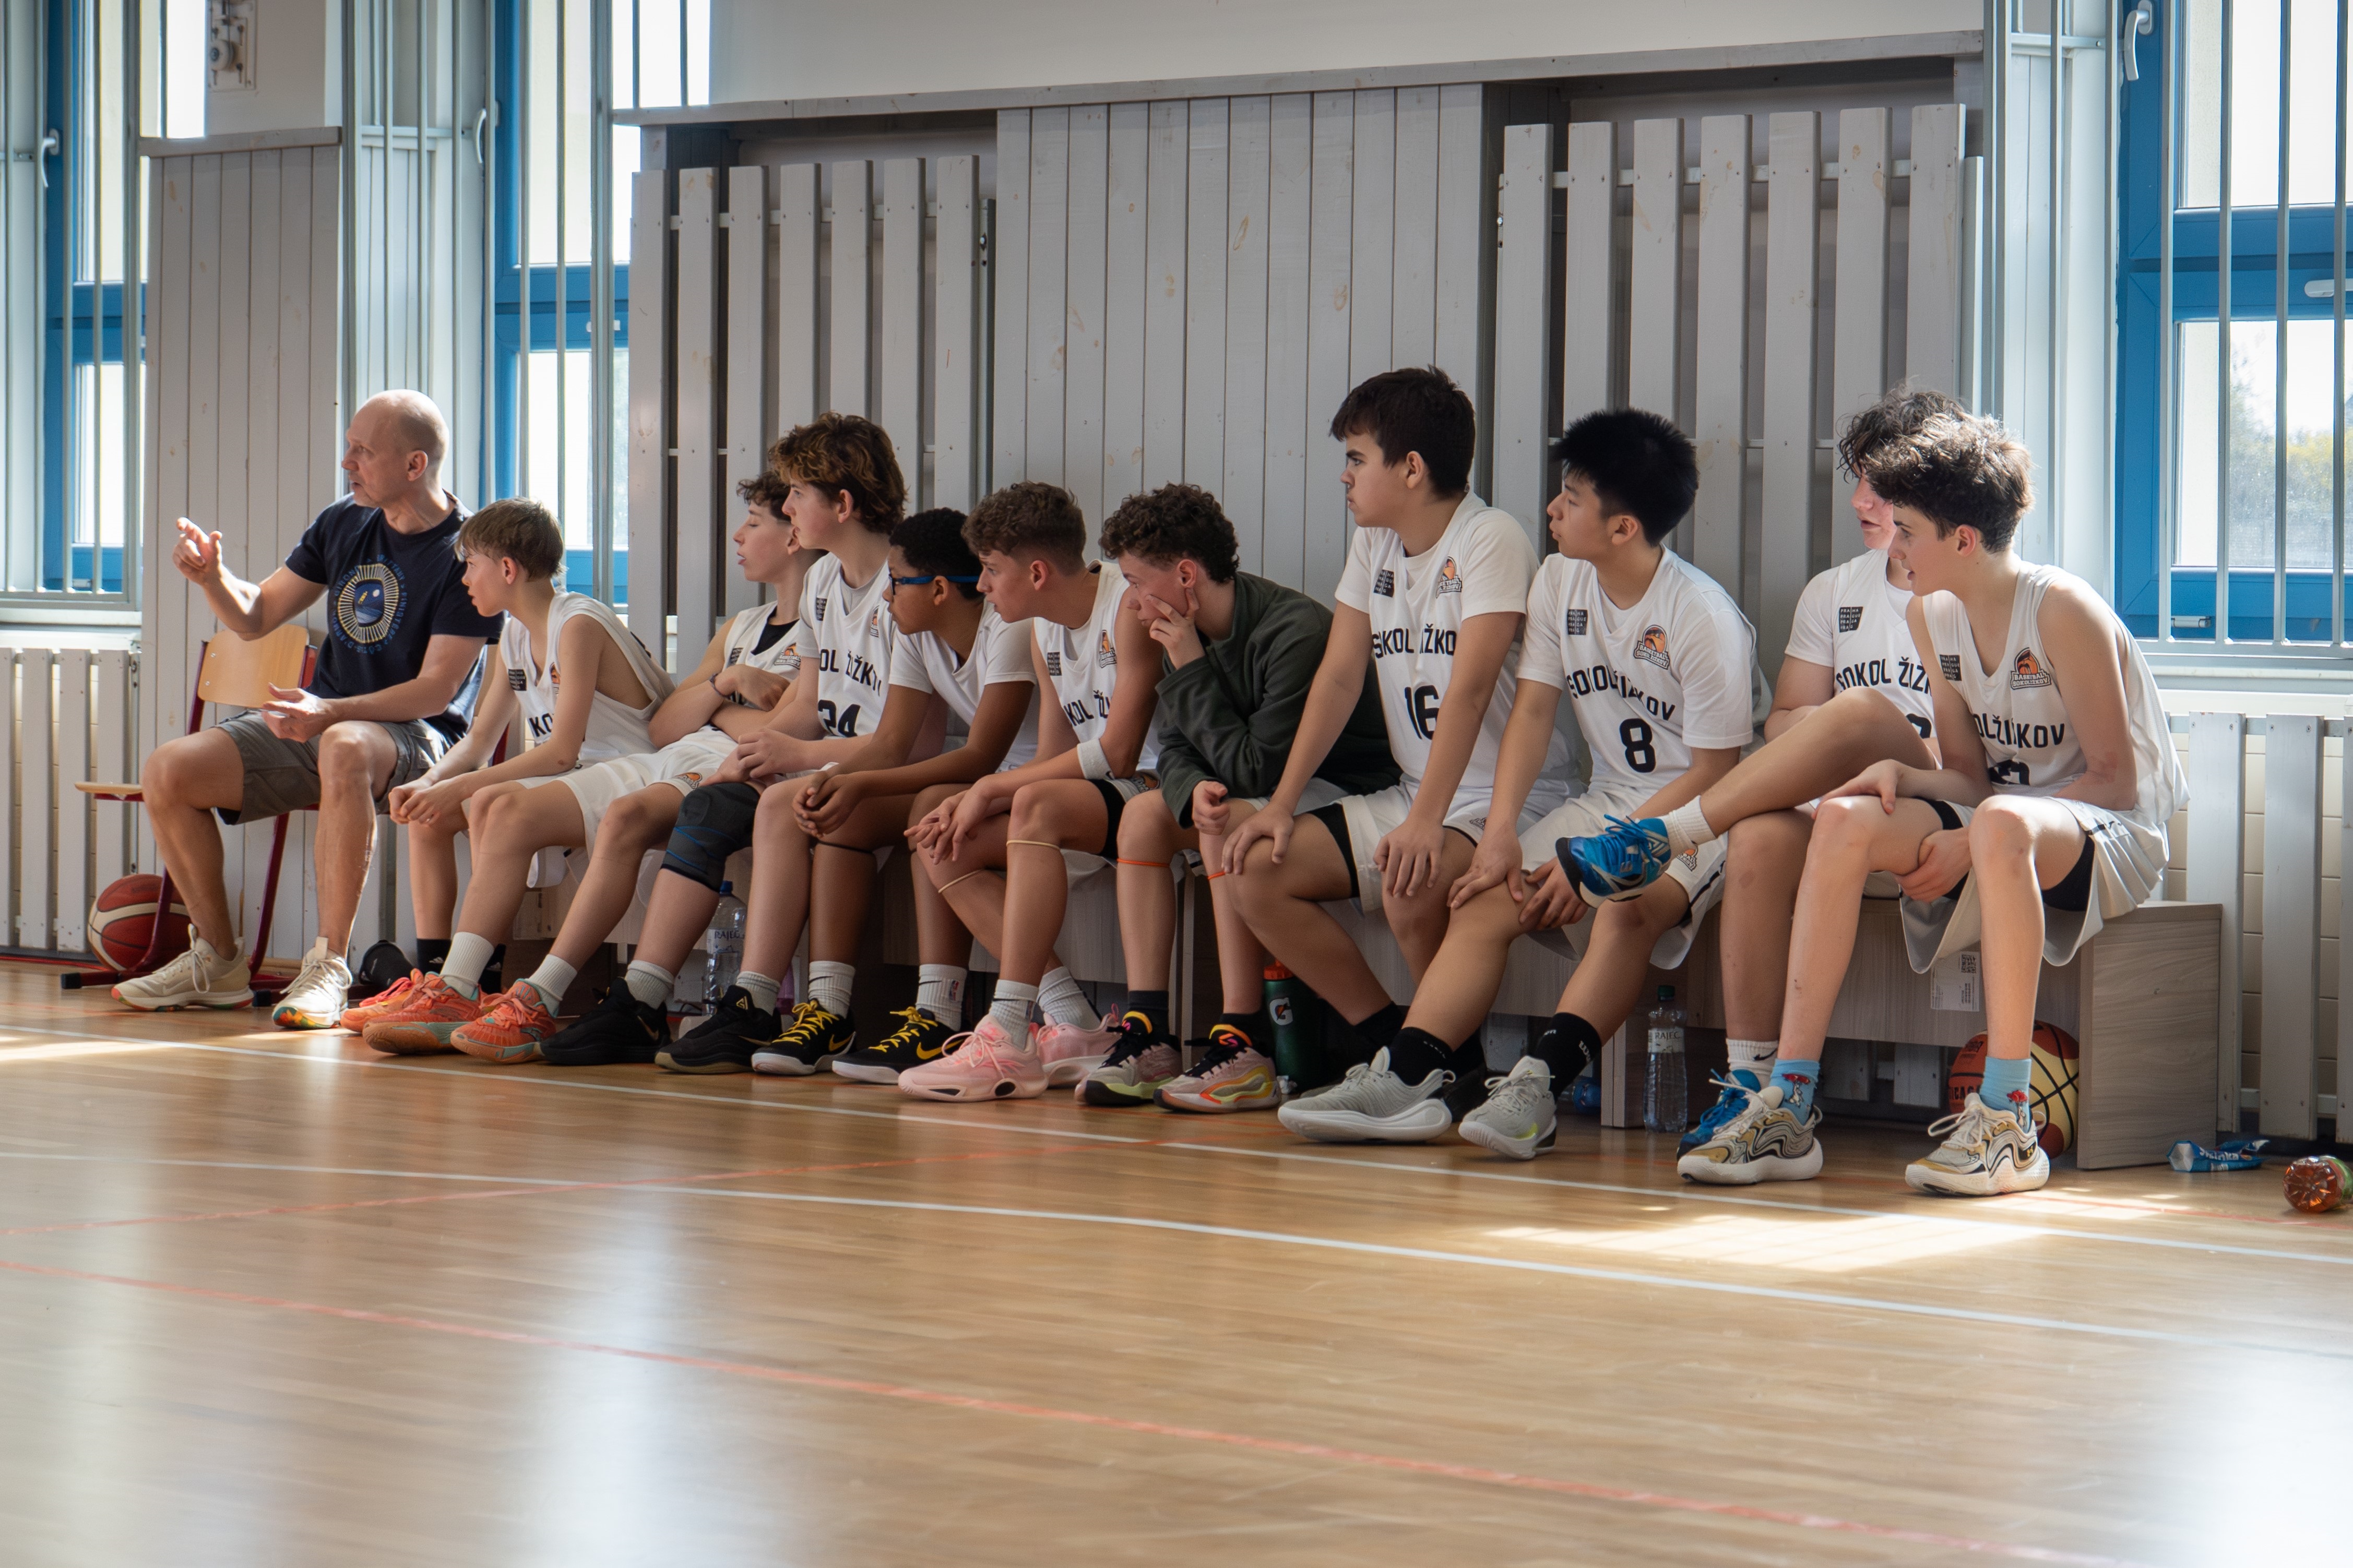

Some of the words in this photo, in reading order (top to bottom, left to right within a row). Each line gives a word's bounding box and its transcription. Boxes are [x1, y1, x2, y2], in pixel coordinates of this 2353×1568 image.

[1372, 628, 1415, 659] SKOL
[817, 699, 861, 738] 24
[1063, 699, 1094, 726] KOL
[1404, 685, 1440, 740] 16
[1619, 718, 1656, 773] 8
